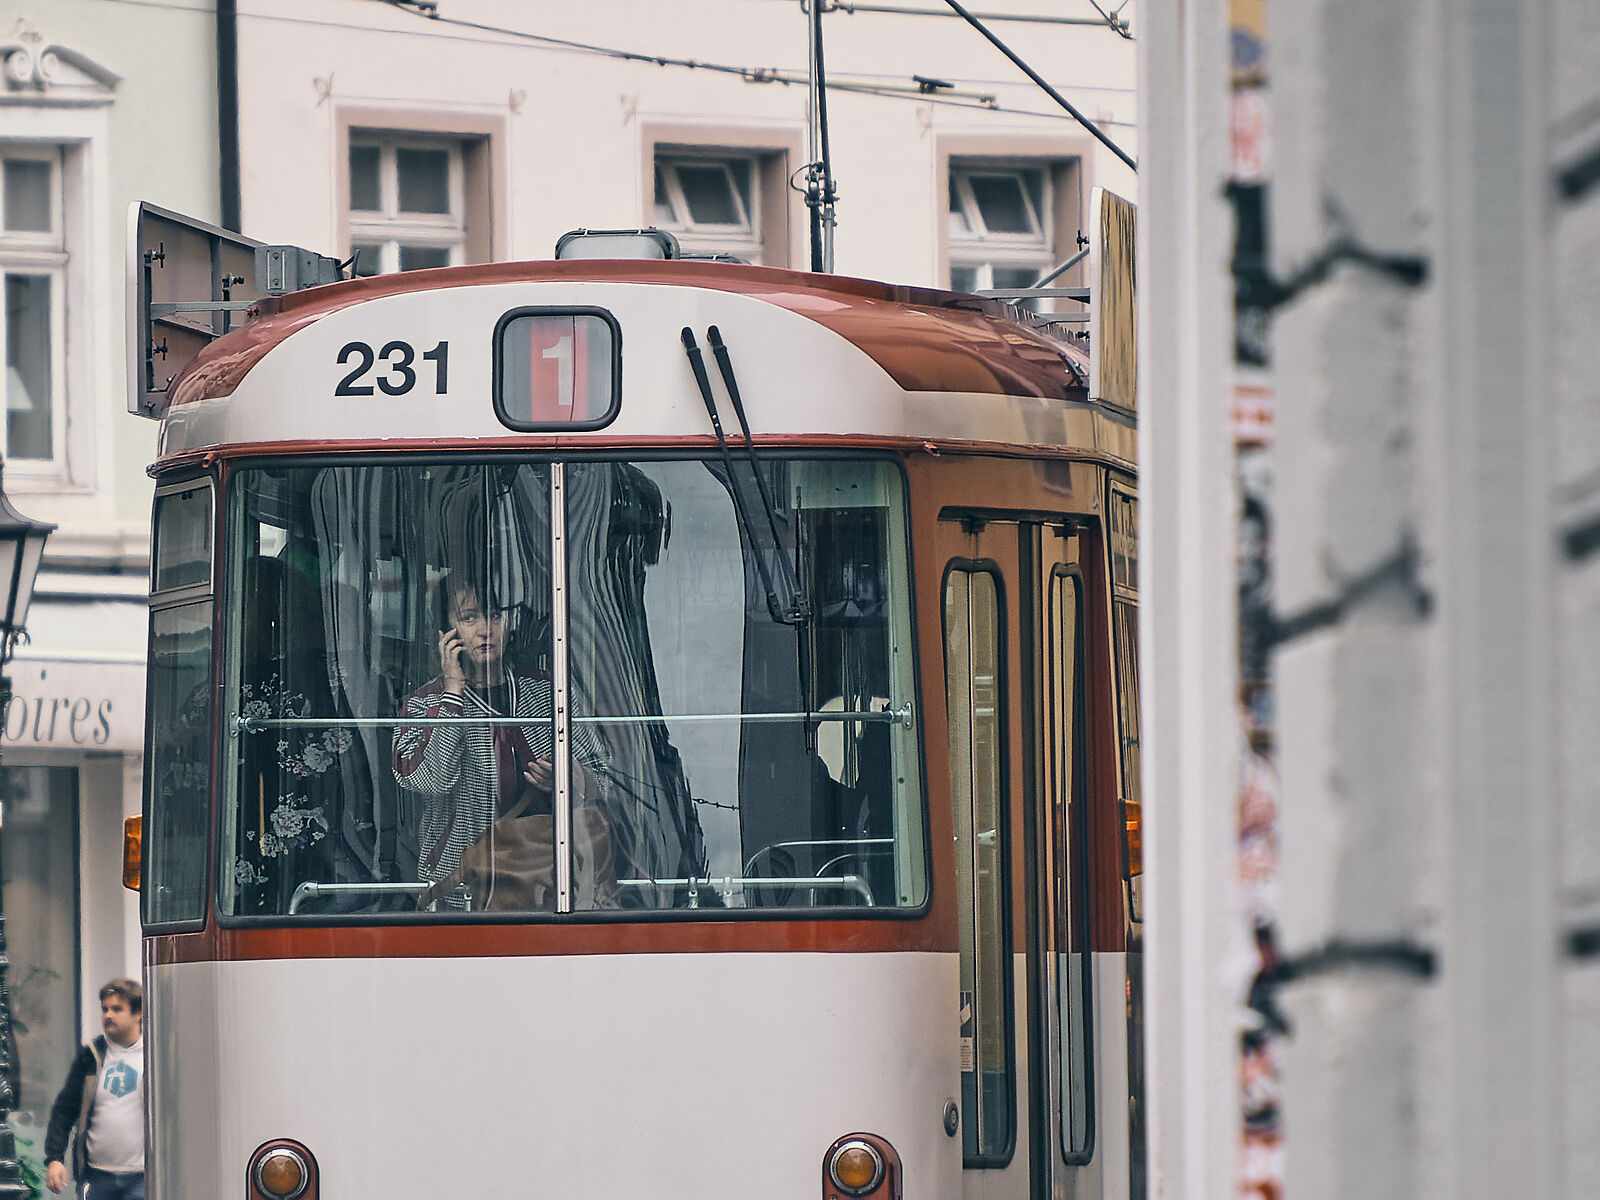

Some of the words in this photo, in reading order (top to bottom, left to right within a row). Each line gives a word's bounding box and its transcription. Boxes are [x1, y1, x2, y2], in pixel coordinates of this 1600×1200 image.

[334, 340, 449, 397] 231
[542, 336, 573, 406] 1
[4, 669, 113, 745] oires
